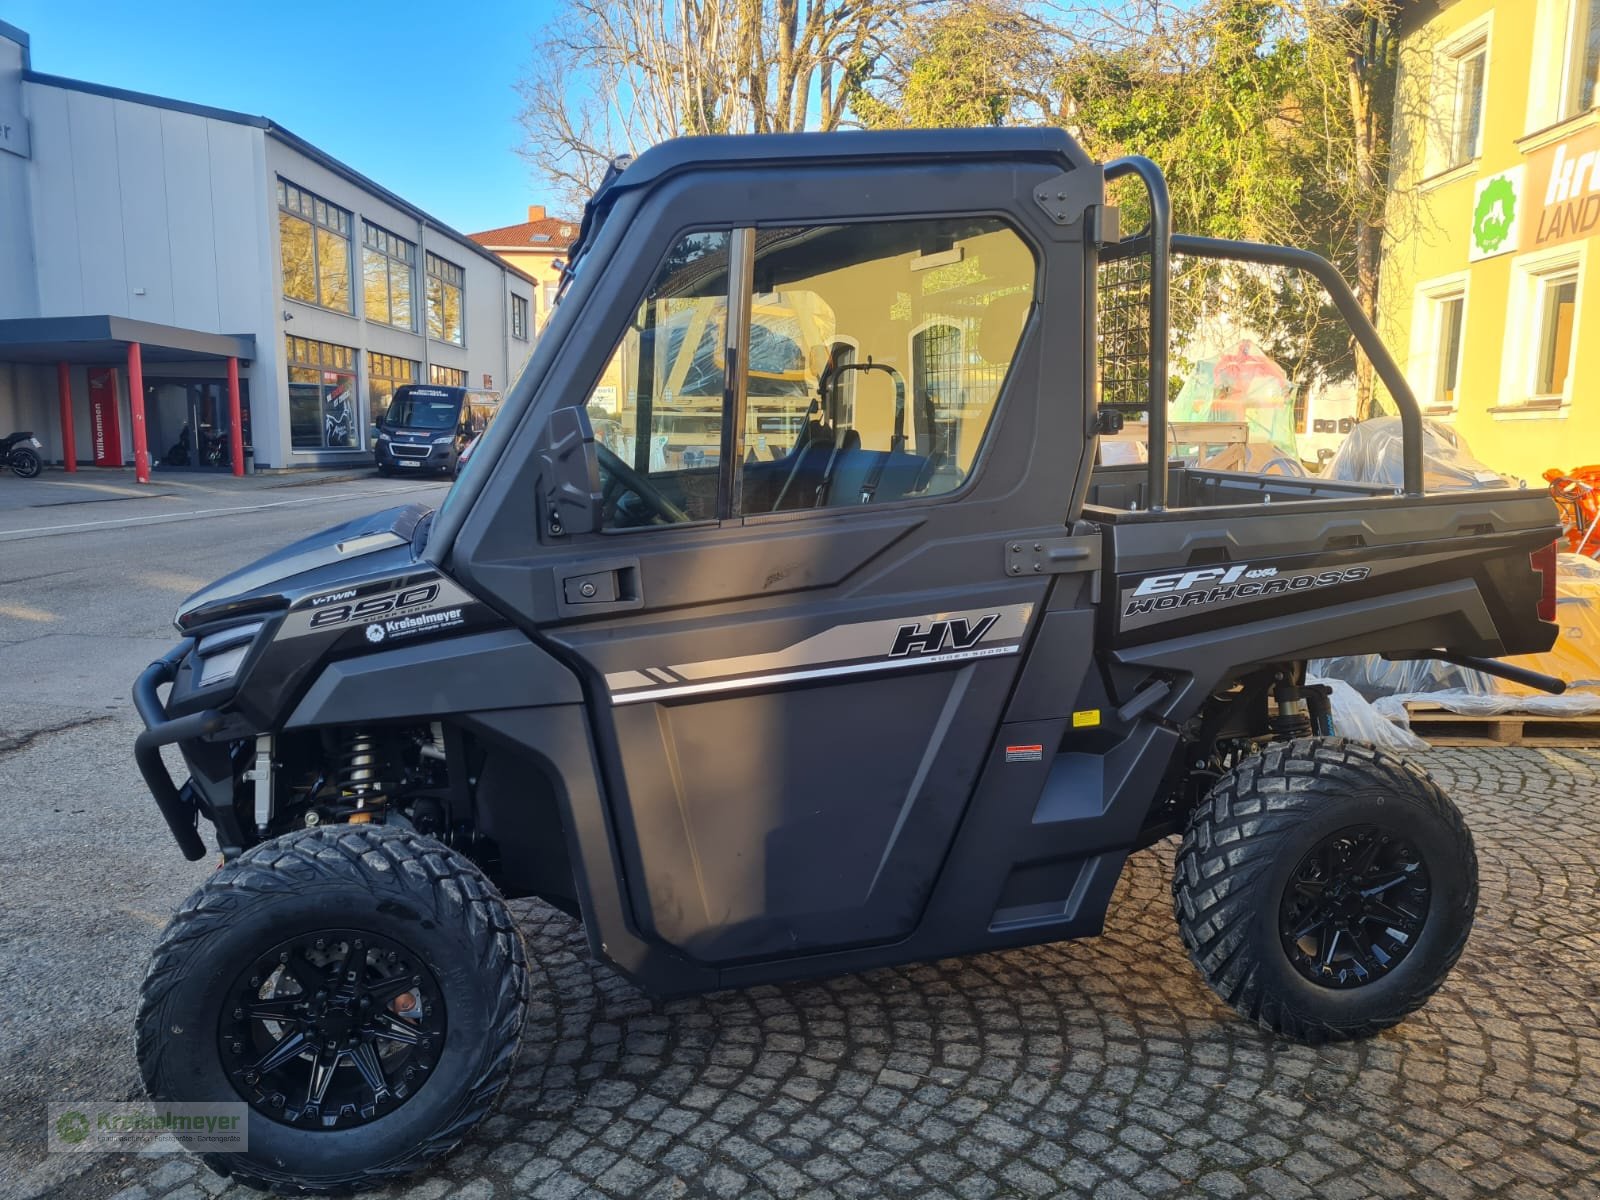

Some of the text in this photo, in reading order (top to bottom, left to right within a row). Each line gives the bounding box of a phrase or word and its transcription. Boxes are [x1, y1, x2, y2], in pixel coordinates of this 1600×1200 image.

[95, 402, 105, 460] Willkommen
[312, 590, 357, 605] V-TWIN
[1123, 567, 1372, 617] WORKCROSS
[1132, 565, 1248, 597] EFI
[310, 583, 441, 630] 850
[385, 609, 463, 632] Kreiselmeyer
[888, 613, 1001, 657] HV
